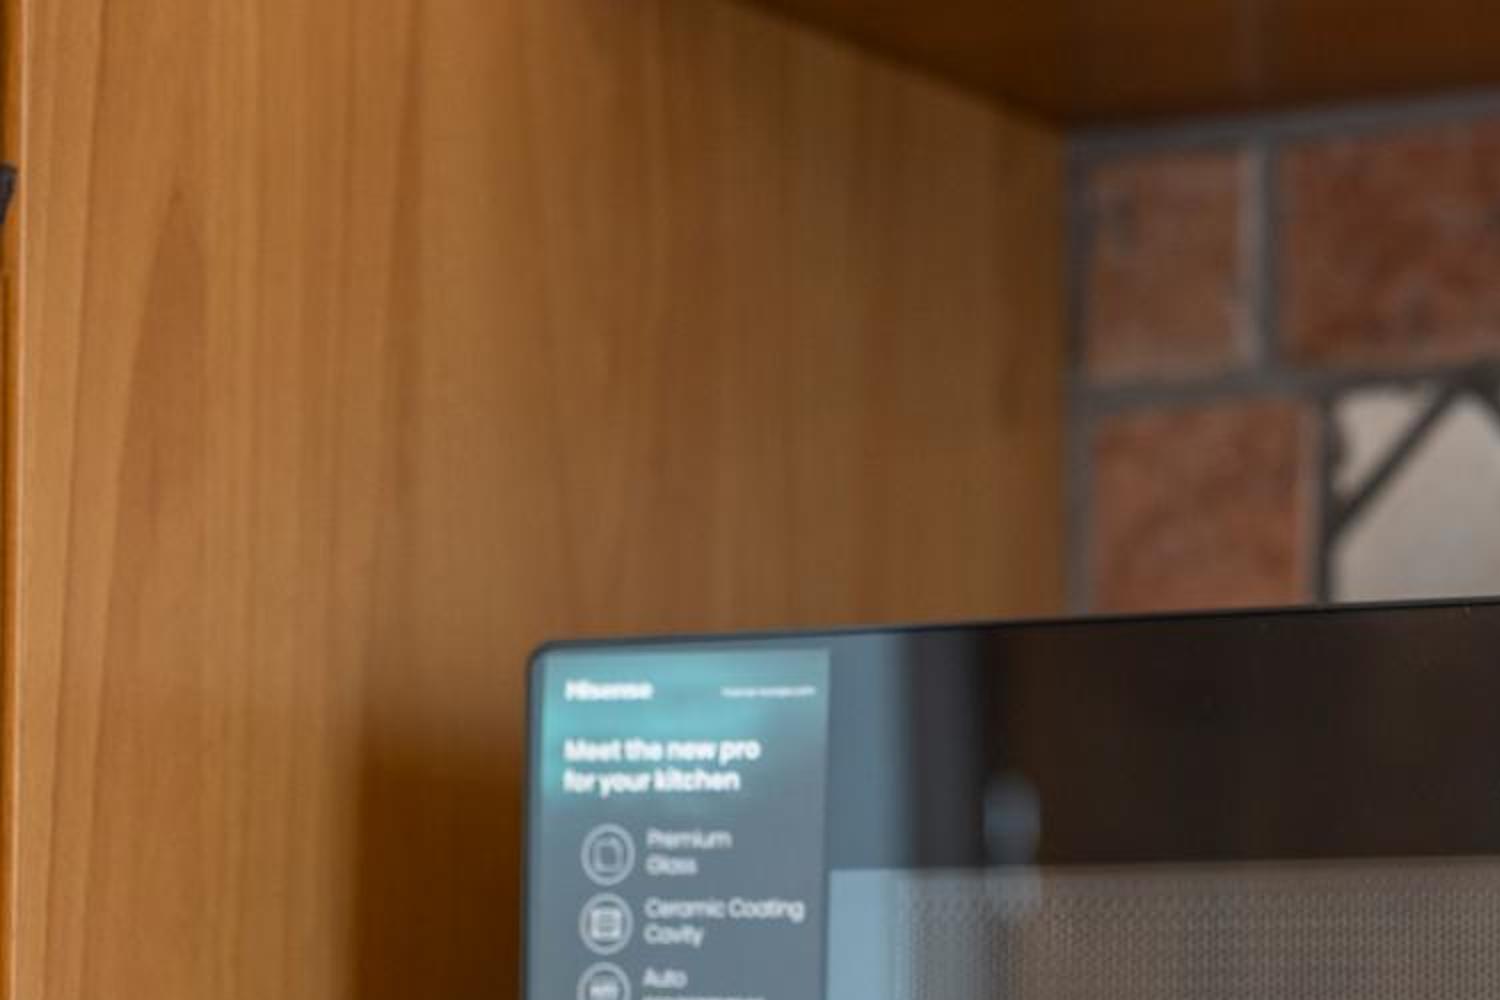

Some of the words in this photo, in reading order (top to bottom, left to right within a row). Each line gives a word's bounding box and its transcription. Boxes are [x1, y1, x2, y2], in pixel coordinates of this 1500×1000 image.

[565, 680, 653, 700] Hisense
[564, 740, 621, 760] Meet
[623, 738, 663, 760] the
[666, 741, 716, 760] new
[718, 740, 761, 765] pro
[563, 769, 596, 792] for
[599, 772, 650, 798] your
[654, 768, 740, 790] kitchen
[646, 828, 732, 848] Premium
[646, 854, 698, 875] Glass
[645, 897, 726, 918] Ceramic
[728, 897, 805, 923] Coating
[644, 924, 704, 948] Cavity
[642, 968, 688, 988] Auto
